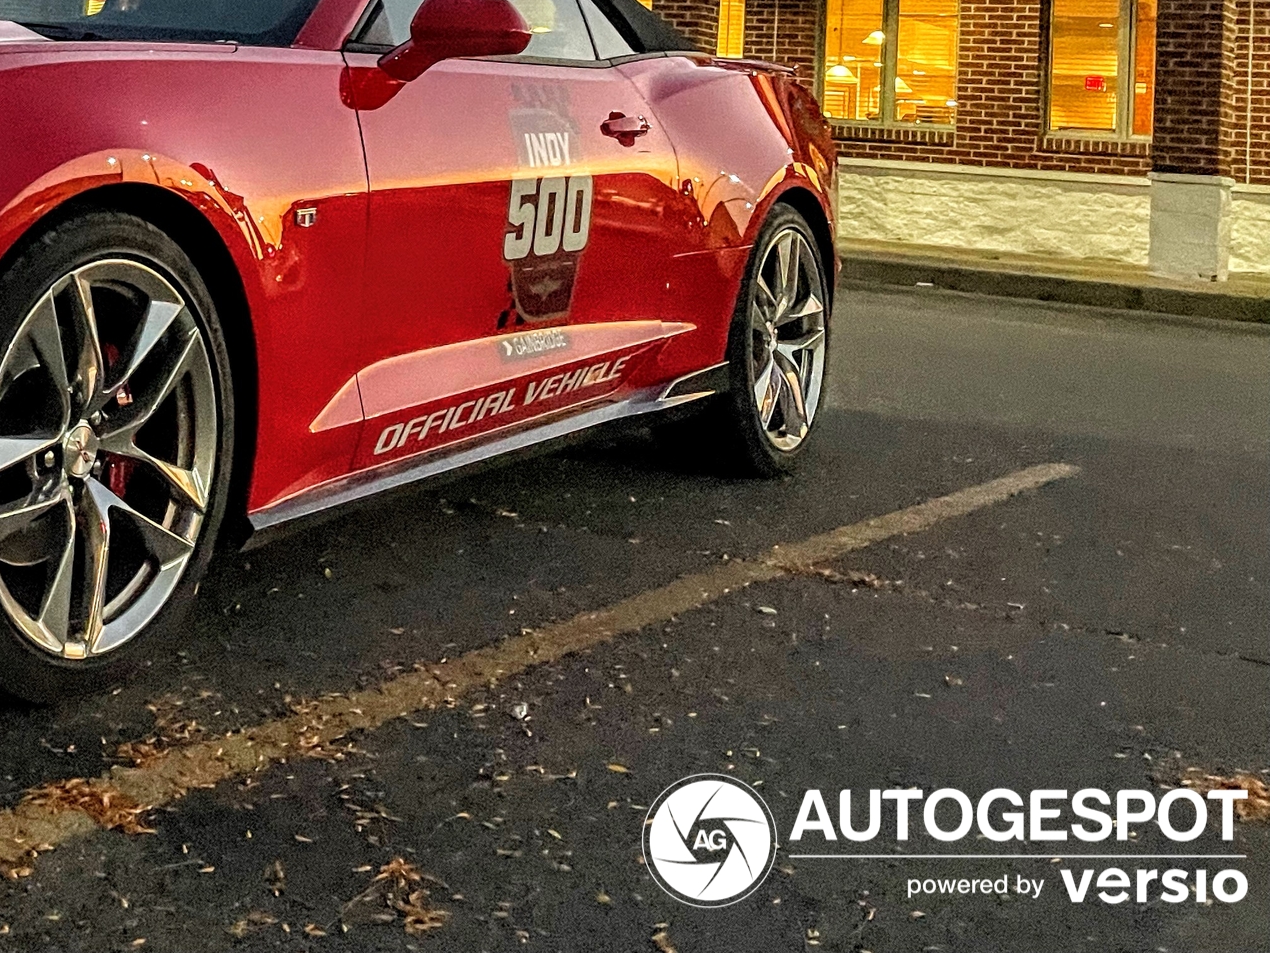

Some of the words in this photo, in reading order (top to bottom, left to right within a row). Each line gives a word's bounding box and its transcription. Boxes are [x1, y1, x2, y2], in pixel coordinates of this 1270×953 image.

[524, 132, 571, 167] INDY
[503, 174, 593, 260] 500
[373, 389, 515, 455] OFFICIAL
[523, 356, 627, 405] VEHICLE
